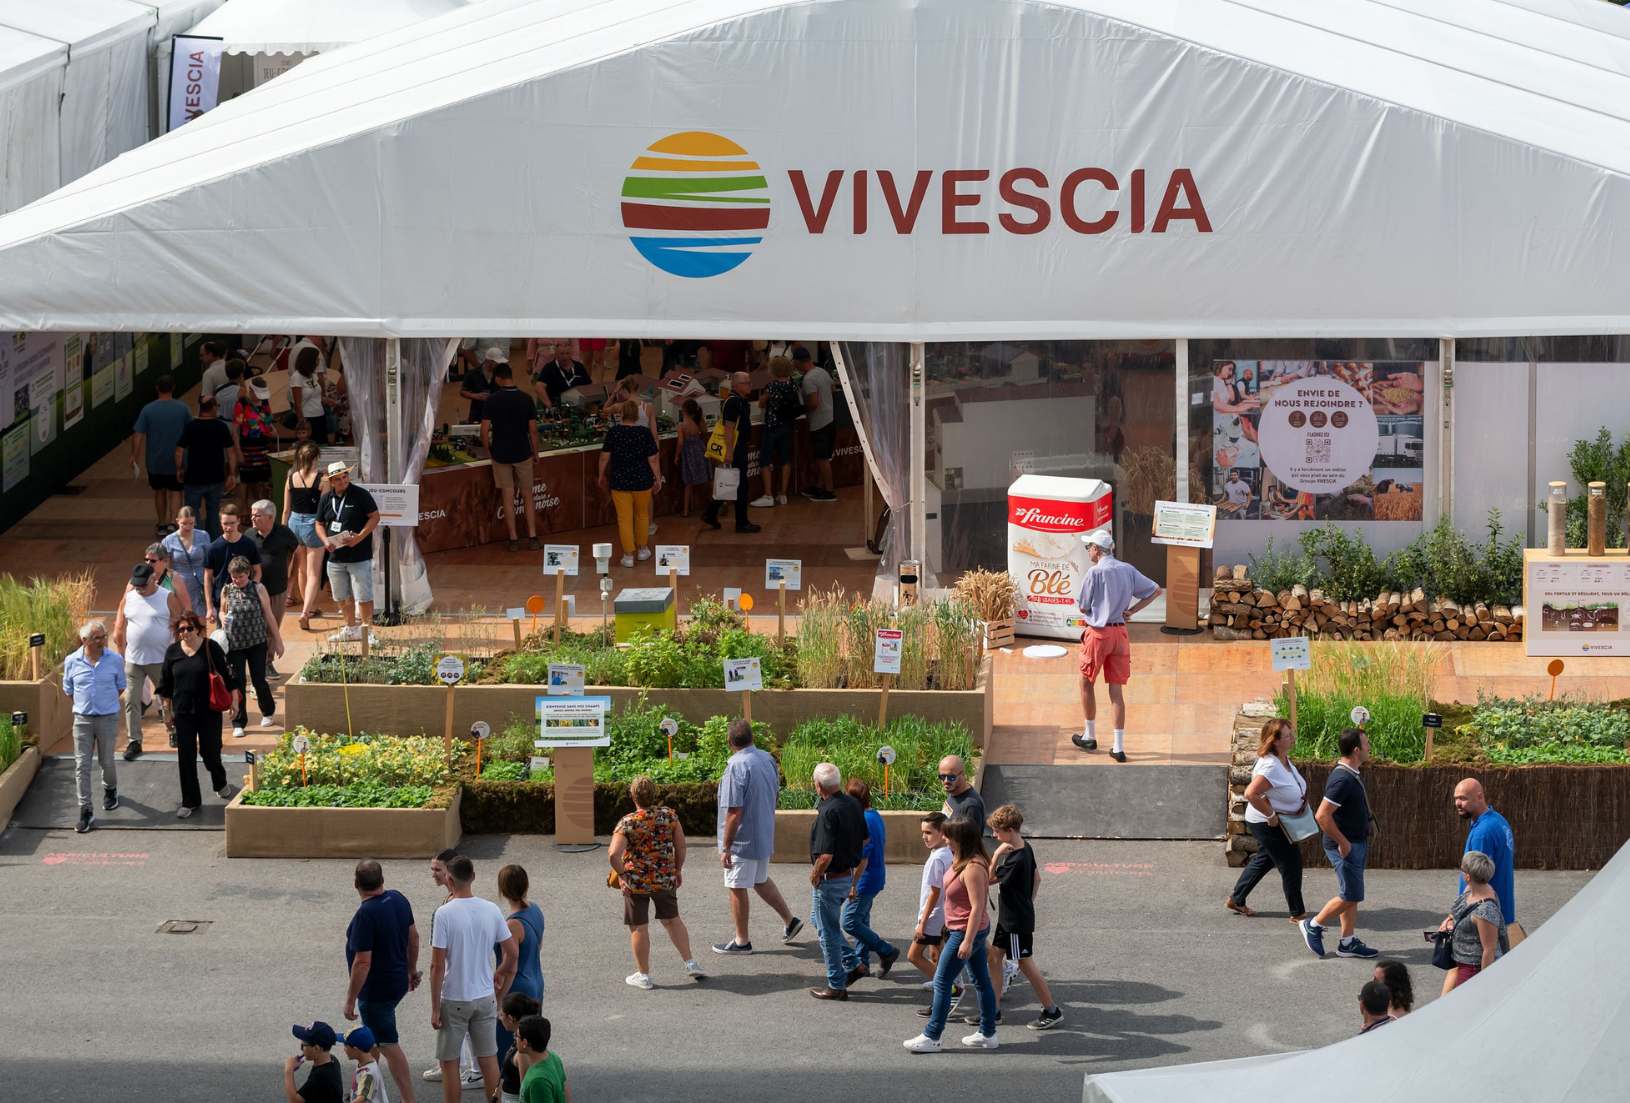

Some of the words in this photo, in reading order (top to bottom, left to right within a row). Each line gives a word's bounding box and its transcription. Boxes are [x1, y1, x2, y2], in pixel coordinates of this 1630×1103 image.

[787, 168, 1213, 235] VIVESCIA
[1304, 400, 1356, 408] REJOINDRE
[710, 443, 722, 457] CR
[835, 445, 865, 456] VIVESC
[418, 509, 446, 521] ESCIA
[1020, 507, 1084, 527] francine
[1062, 563, 1070, 571] DE
[1027, 568, 1071, 595] Blé
